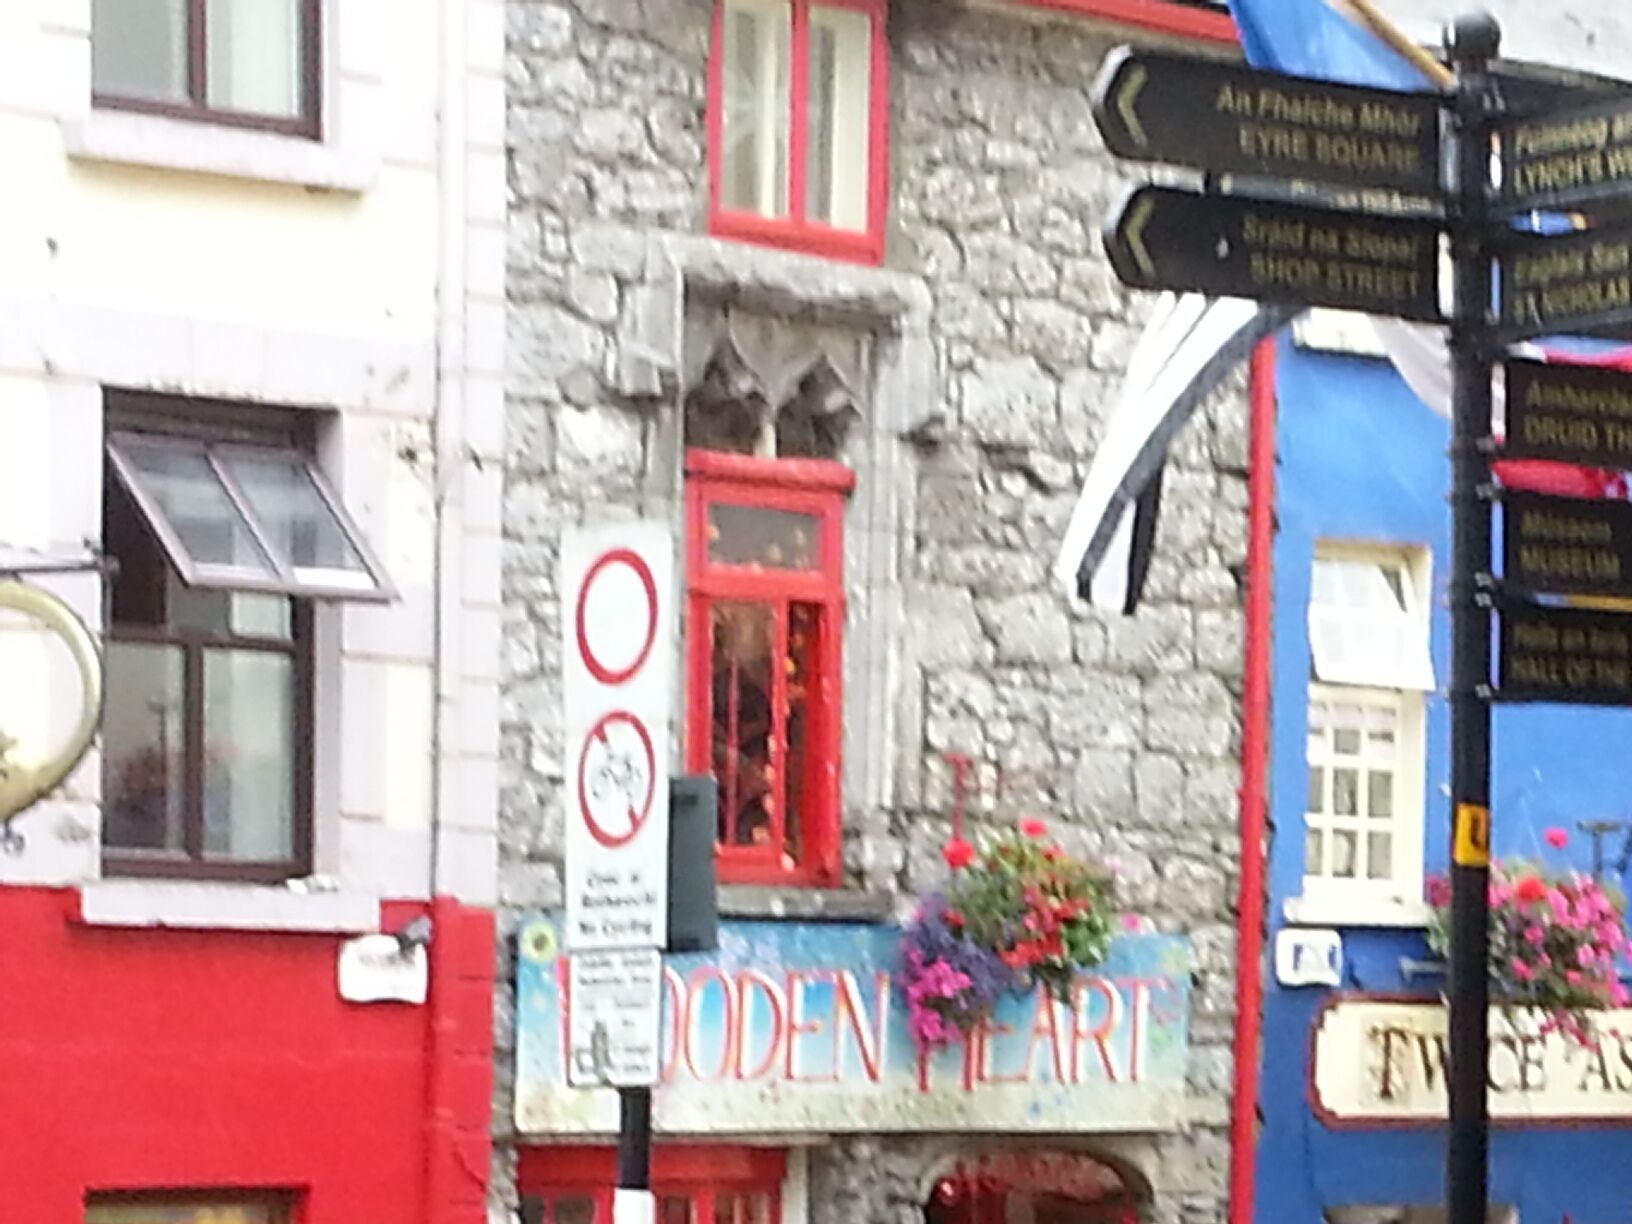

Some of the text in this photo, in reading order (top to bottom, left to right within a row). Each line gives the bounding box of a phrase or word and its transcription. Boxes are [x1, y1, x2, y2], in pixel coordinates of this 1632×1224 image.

[1239, 124, 1420, 173] EYRE SQUARE
[1514, 151, 1603, 196] LYNCH'S
[1251, 253, 1419, 298] SHOP STREET
[1524, 413, 1599, 449] DRUID
[1519, 545, 1621, 580] MUSEUM
